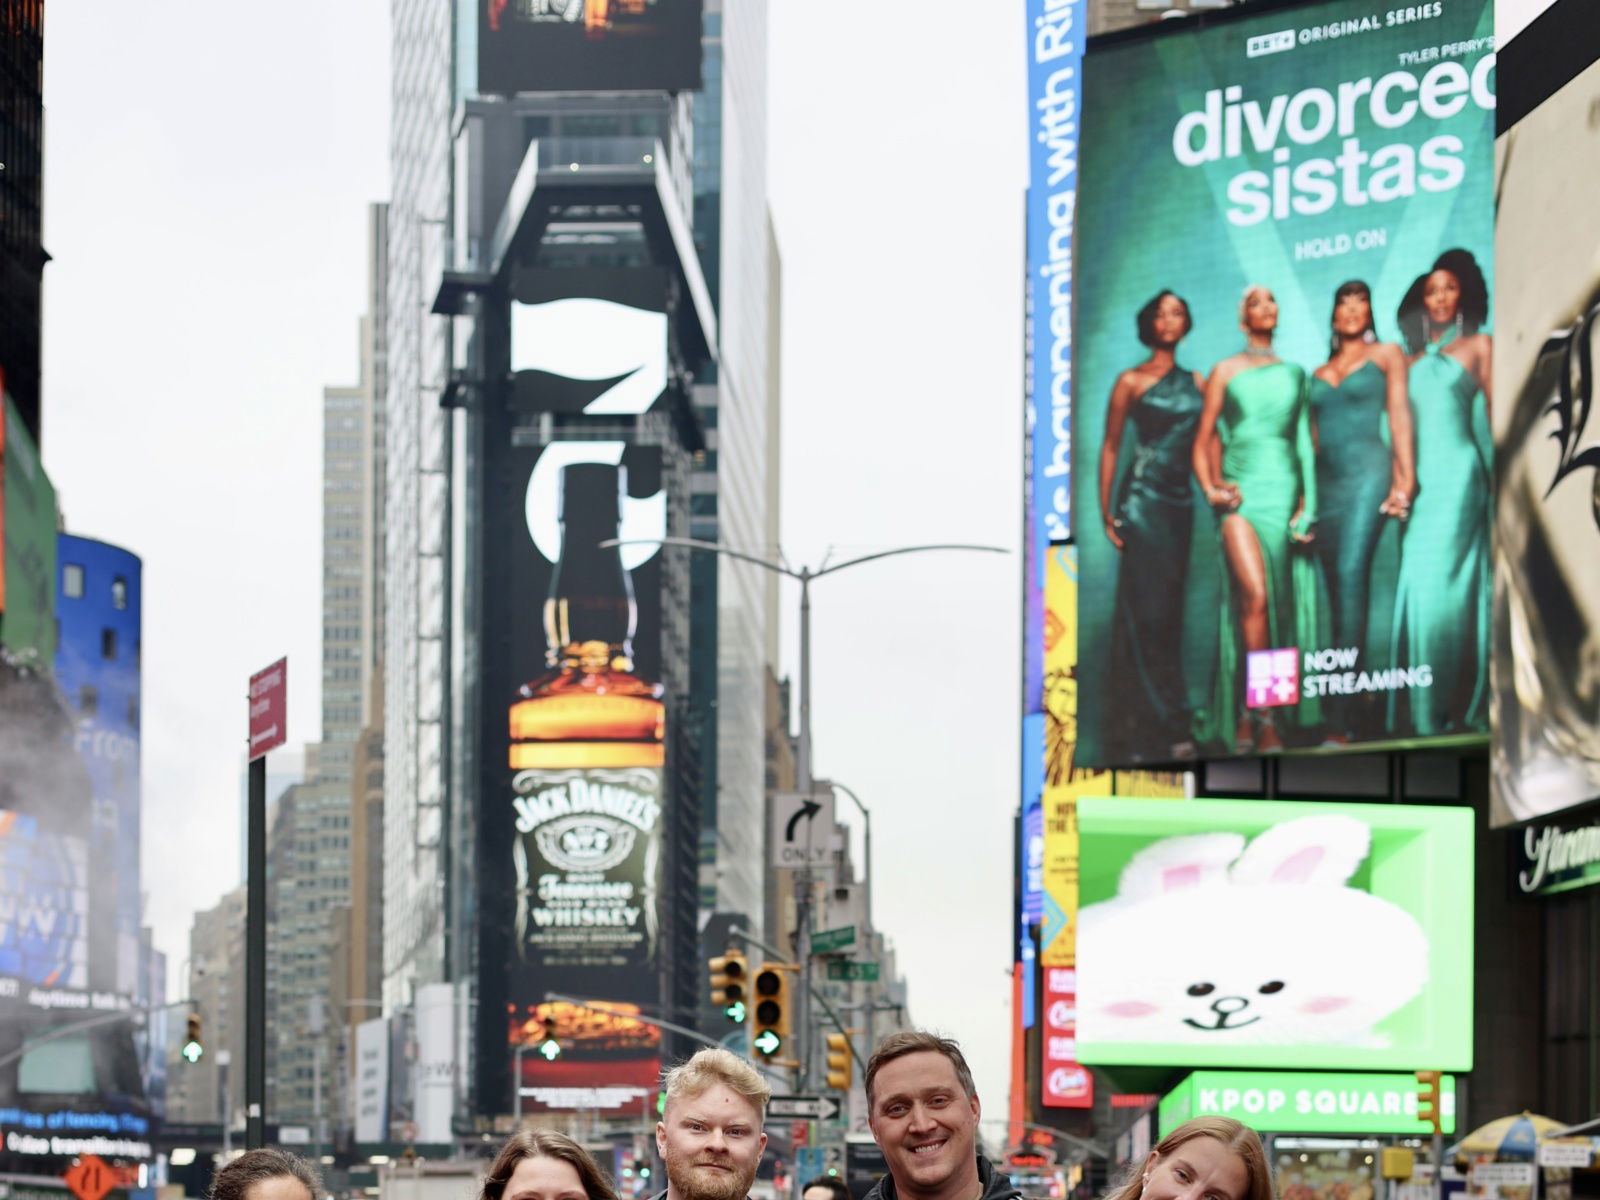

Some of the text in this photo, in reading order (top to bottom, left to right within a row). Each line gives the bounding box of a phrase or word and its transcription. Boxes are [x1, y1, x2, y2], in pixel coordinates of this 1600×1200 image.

[1298, 16, 1382, 45] ORIGINAL
[1385, 2, 1443, 26] SERIES
[1398, 35, 1496, 66] TYLER PERRY'S
[1034, 66, 1077, 187] with
[1226, 135, 1466, 226] sistas
[1294, 228, 1387, 262] HOLD ON
[1303, 646, 1359, 673] NOW
[1302, 664, 1434, 698] STREAMING
[513, 785, 571, 833] JACK
[782, 847, 826, 863] ONLY
[532, 908, 640, 927] WHISKEY
[1199, 1088, 1286, 1114] KPOP
[1295, 1089, 1419, 1115] SQUARE
